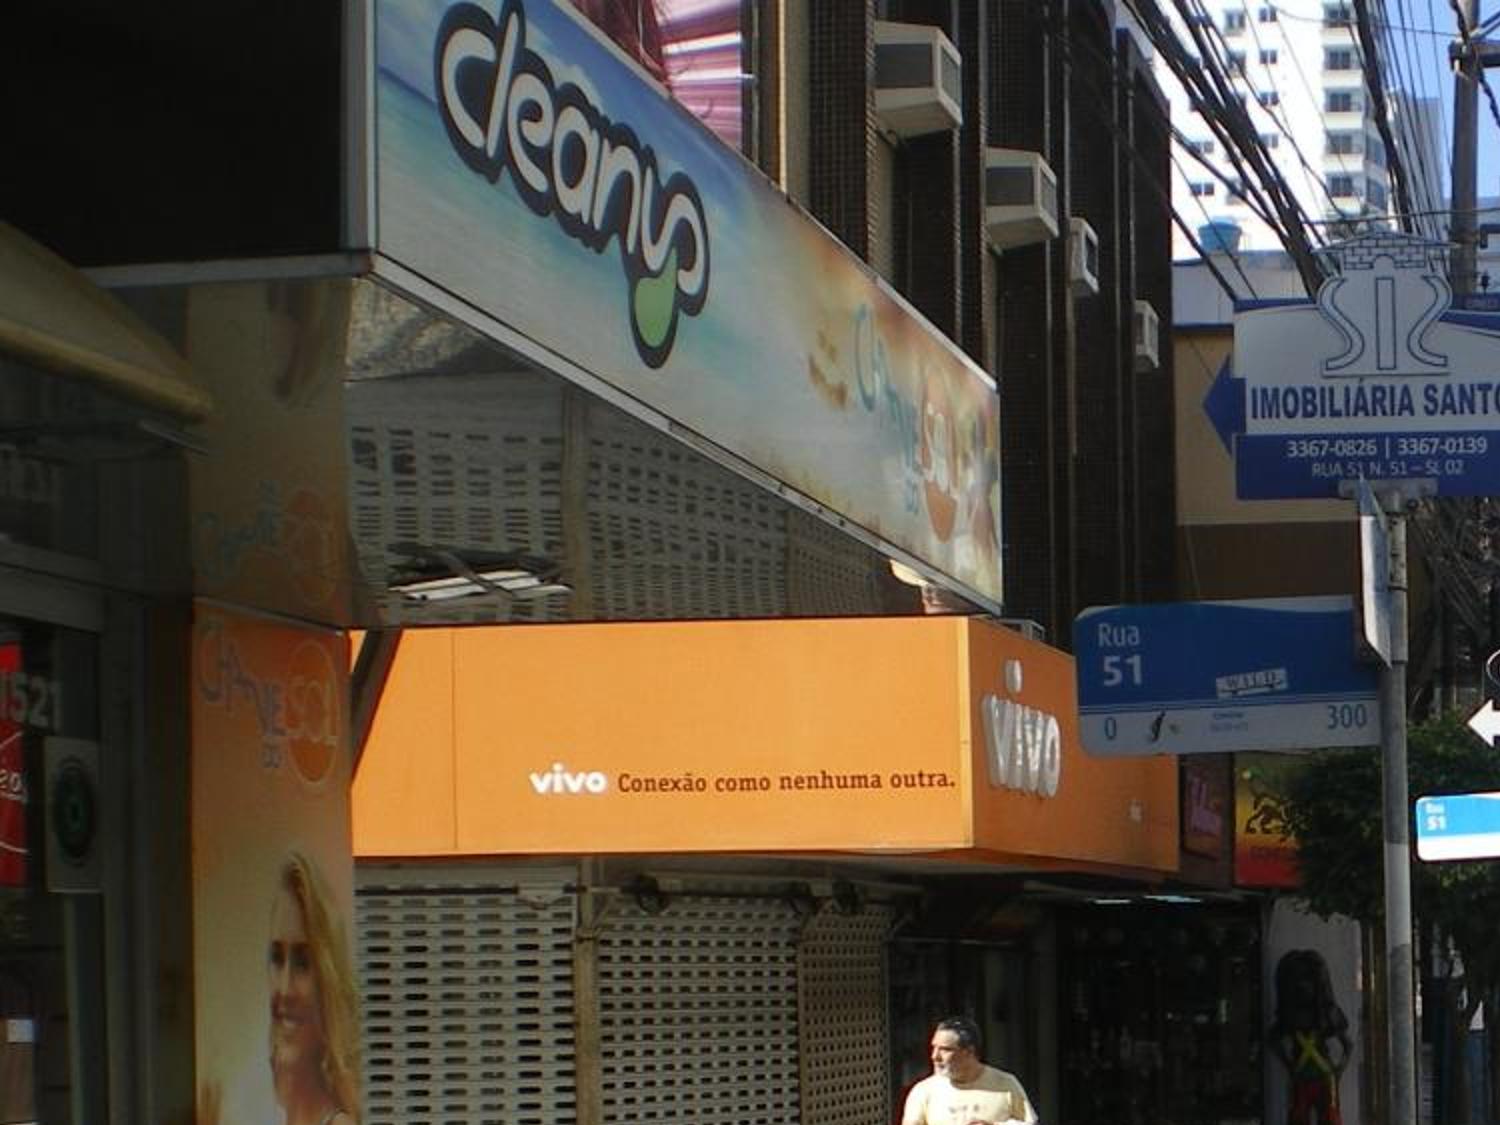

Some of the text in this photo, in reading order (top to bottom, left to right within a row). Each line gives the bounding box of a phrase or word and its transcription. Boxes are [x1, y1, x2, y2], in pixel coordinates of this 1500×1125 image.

[1251, 378, 1415, 420] IMOBILIÁRIA
[1286, 436, 1489, 458] 3367-0826 3367-0139
[1311, 462, 1343, 477] RUA
[1390, 460, 1408, 476] 51
[1444, 459, 1465, 475] 02
[1098, 623, 1140, 647] Rua
[1102, 654, 1143, 687] 51
[1103, 717, 1117, 741] 0
[1327, 704, 1367, 730] 300
[529, 762, 956, 793] vivo Conexão como nenhuma outra.
[1426, 815, 1447, 832] 51
